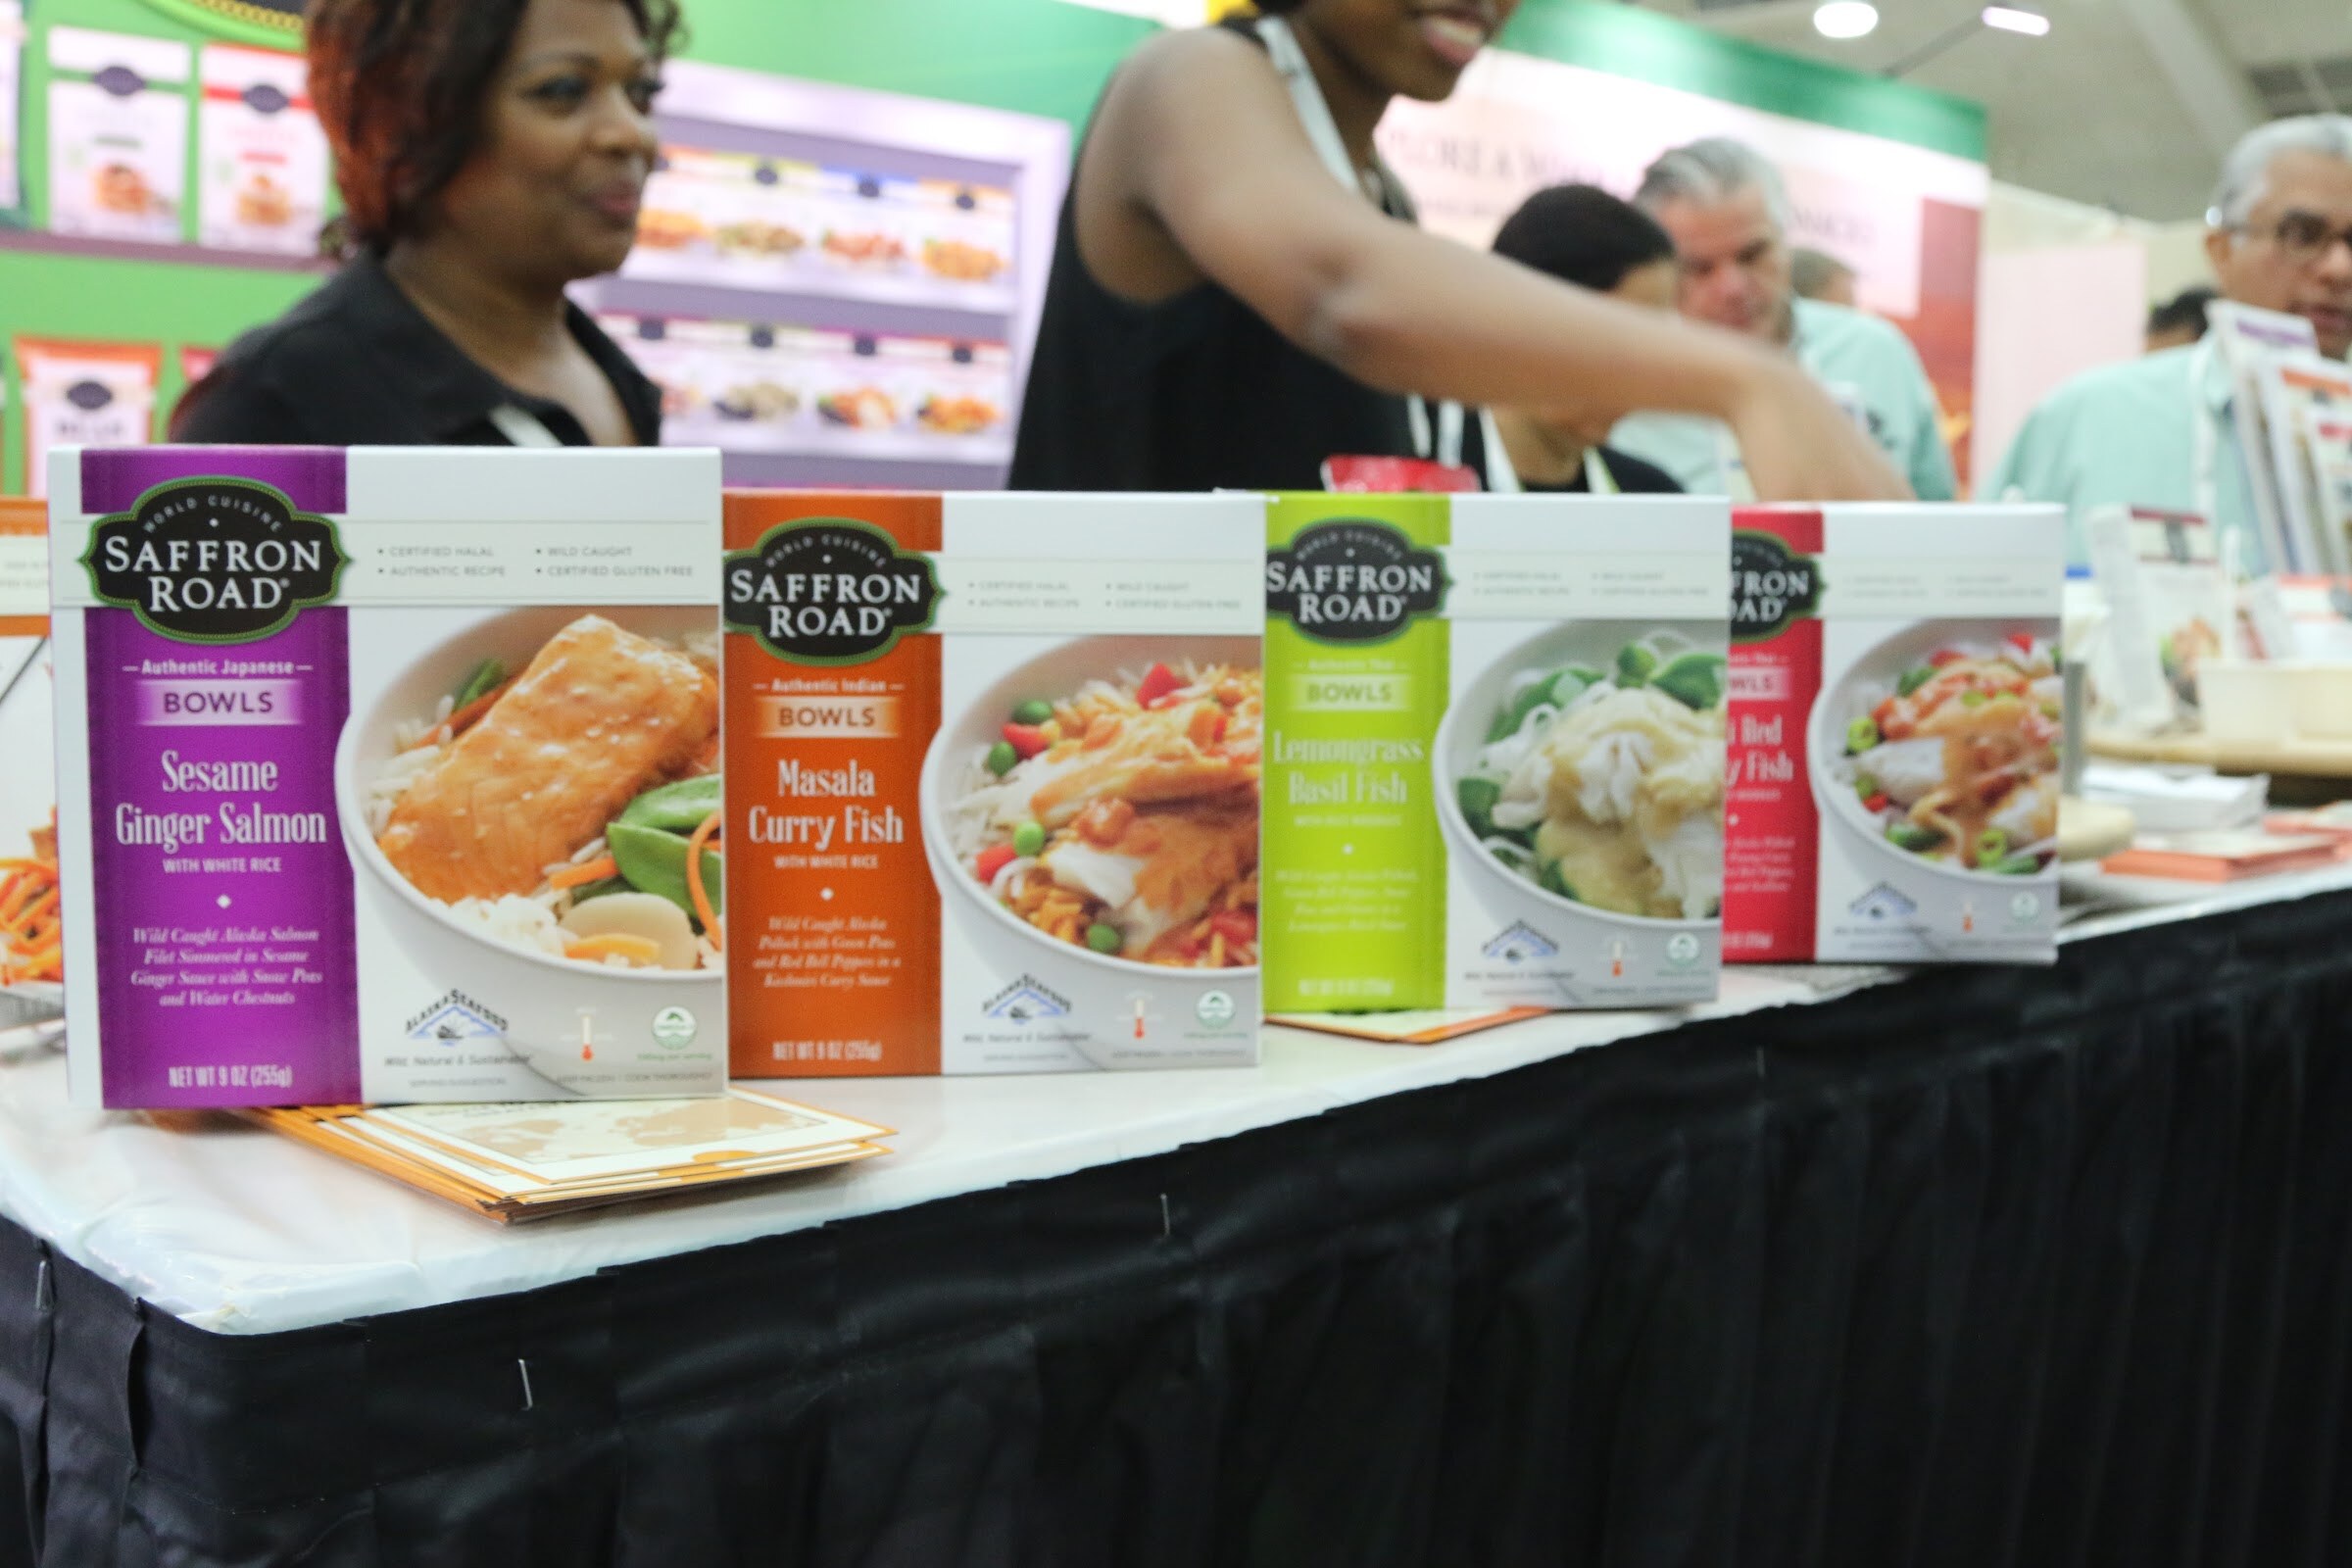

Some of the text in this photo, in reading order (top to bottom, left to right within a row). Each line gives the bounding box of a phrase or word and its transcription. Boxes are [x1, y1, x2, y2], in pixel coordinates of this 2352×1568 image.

[144, 495, 283, 533] WORLD CUISINE
[105, 535, 321, 572] SAFFRON
[389, 546, 494, 557] CERTIFIED HALAL
[547, 546, 632, 557] WILD CAUGHT
[390, 565, 506, 576] AUTHENTIC RECIPE
[547, 565, 693, 576] CERTIFIED GLUTEN FREE
[1266, 561, 1433, 593] SAFFRON
[1732, 569, 1810, 597] FRON
[148, 575, 283, 612] ROAD
[730, 568, 921, 604] SAFFRON
[767, 605, 886, 638] ROAD
[1298, 593, 1402, 623] ROAD
[1731, 595, 1784, 622] AD
[142, 659, 294, 678] Authentic Japanese
[1731, 677, 1770, 689] WLS
[771, 678, 887, 693] Authentic Indian
[1306, 682, 1393, 704] BOWLS
[164, 692, 273, 713] BOWLS
[778, 707, 875, 727] BOWLS
[1740, 713, 1783, 745] Red
[1273, 730, 1424, 766] Lemongrass
[161, 750, 278, 792] Sesame
[777, 759, 876, 797] Masala
[1746, 750, 1794, 782] Fish
[1289, 770, 1407, 805] Basil Fish
[116, 801, 327, 855] Ginger Salmon
[748, 805, 905, 852] Curry Fish
[163, 857, 282, 873] WITH WHITE RICE
[773, 855, 878, 869] WITH WHITE RICE
[168, 1064, 293, 1089] NET WT 9 OZ (255g)
